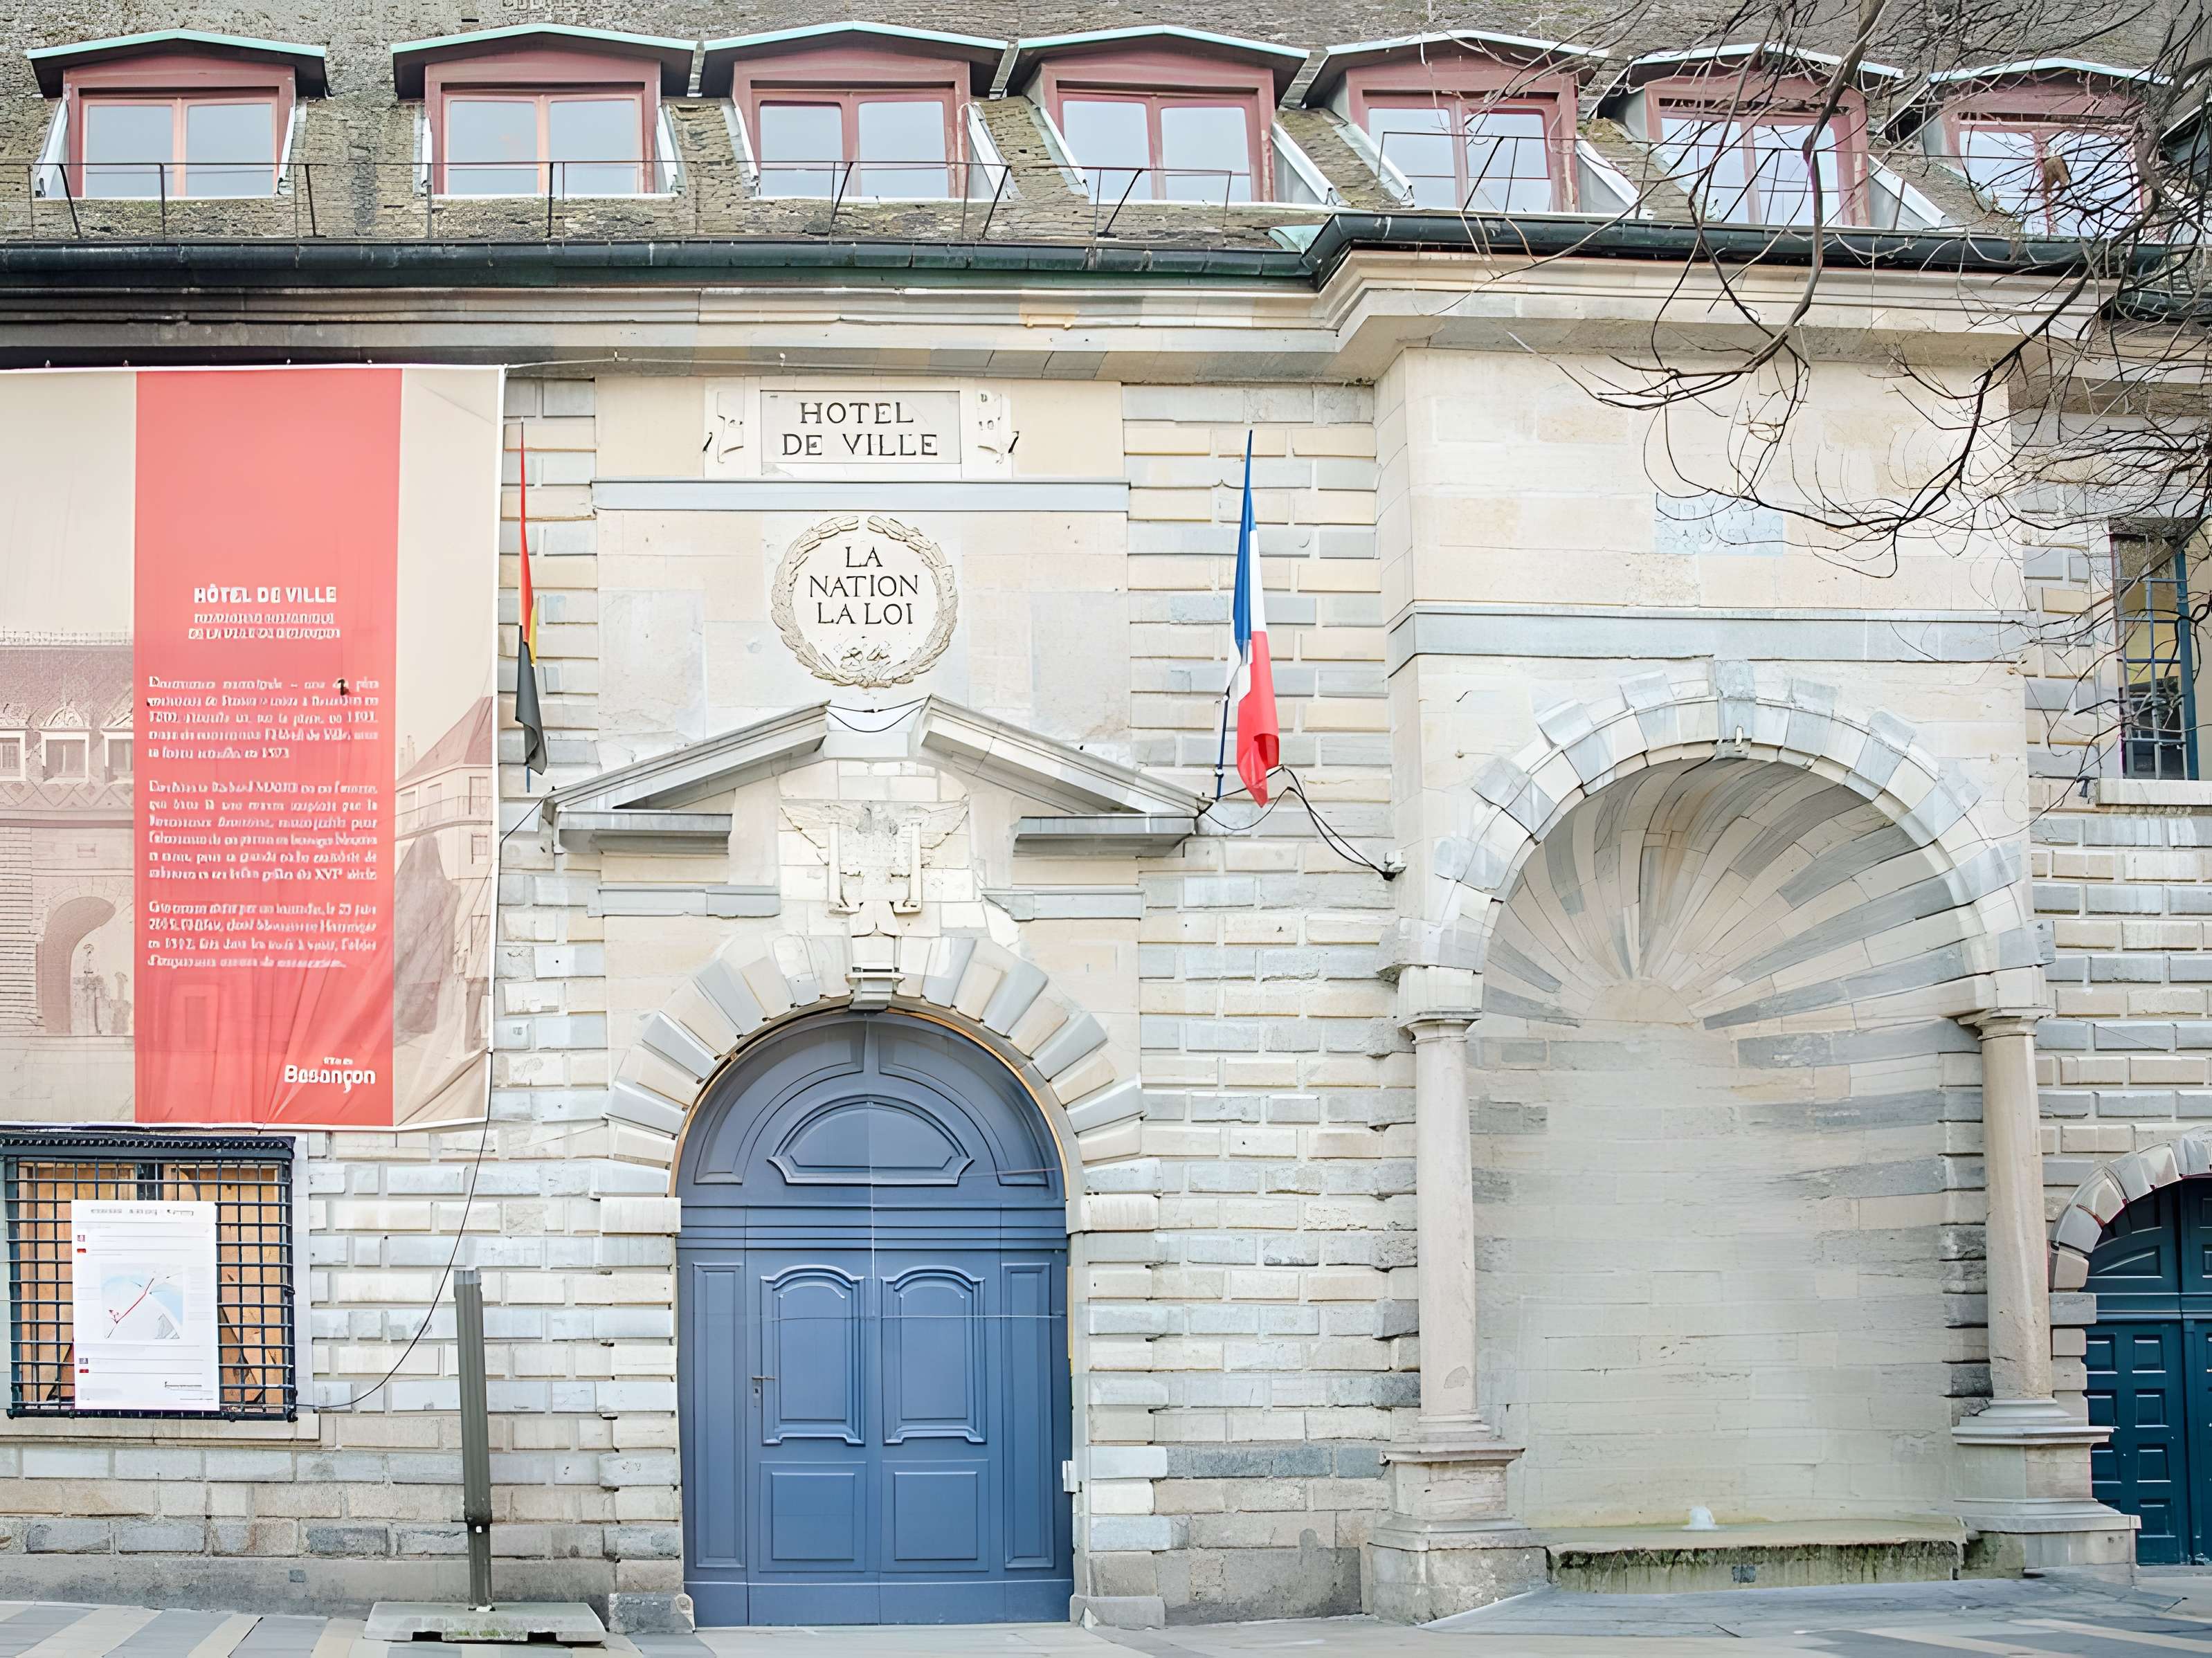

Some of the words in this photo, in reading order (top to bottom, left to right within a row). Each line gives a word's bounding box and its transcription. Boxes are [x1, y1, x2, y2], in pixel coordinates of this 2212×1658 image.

[799, 401, 914, 424] HOTEL
[782, 433, 822, 456] DE
[842, 433, 938, 456] VILLE
[845, 546, 883, 567] LA
[285, 586, 337, 603] VILLE
[810, 574, 918, 598] NATION
[817, 602, 856, 625] LA
[864, 603, 913, 626] LOI
